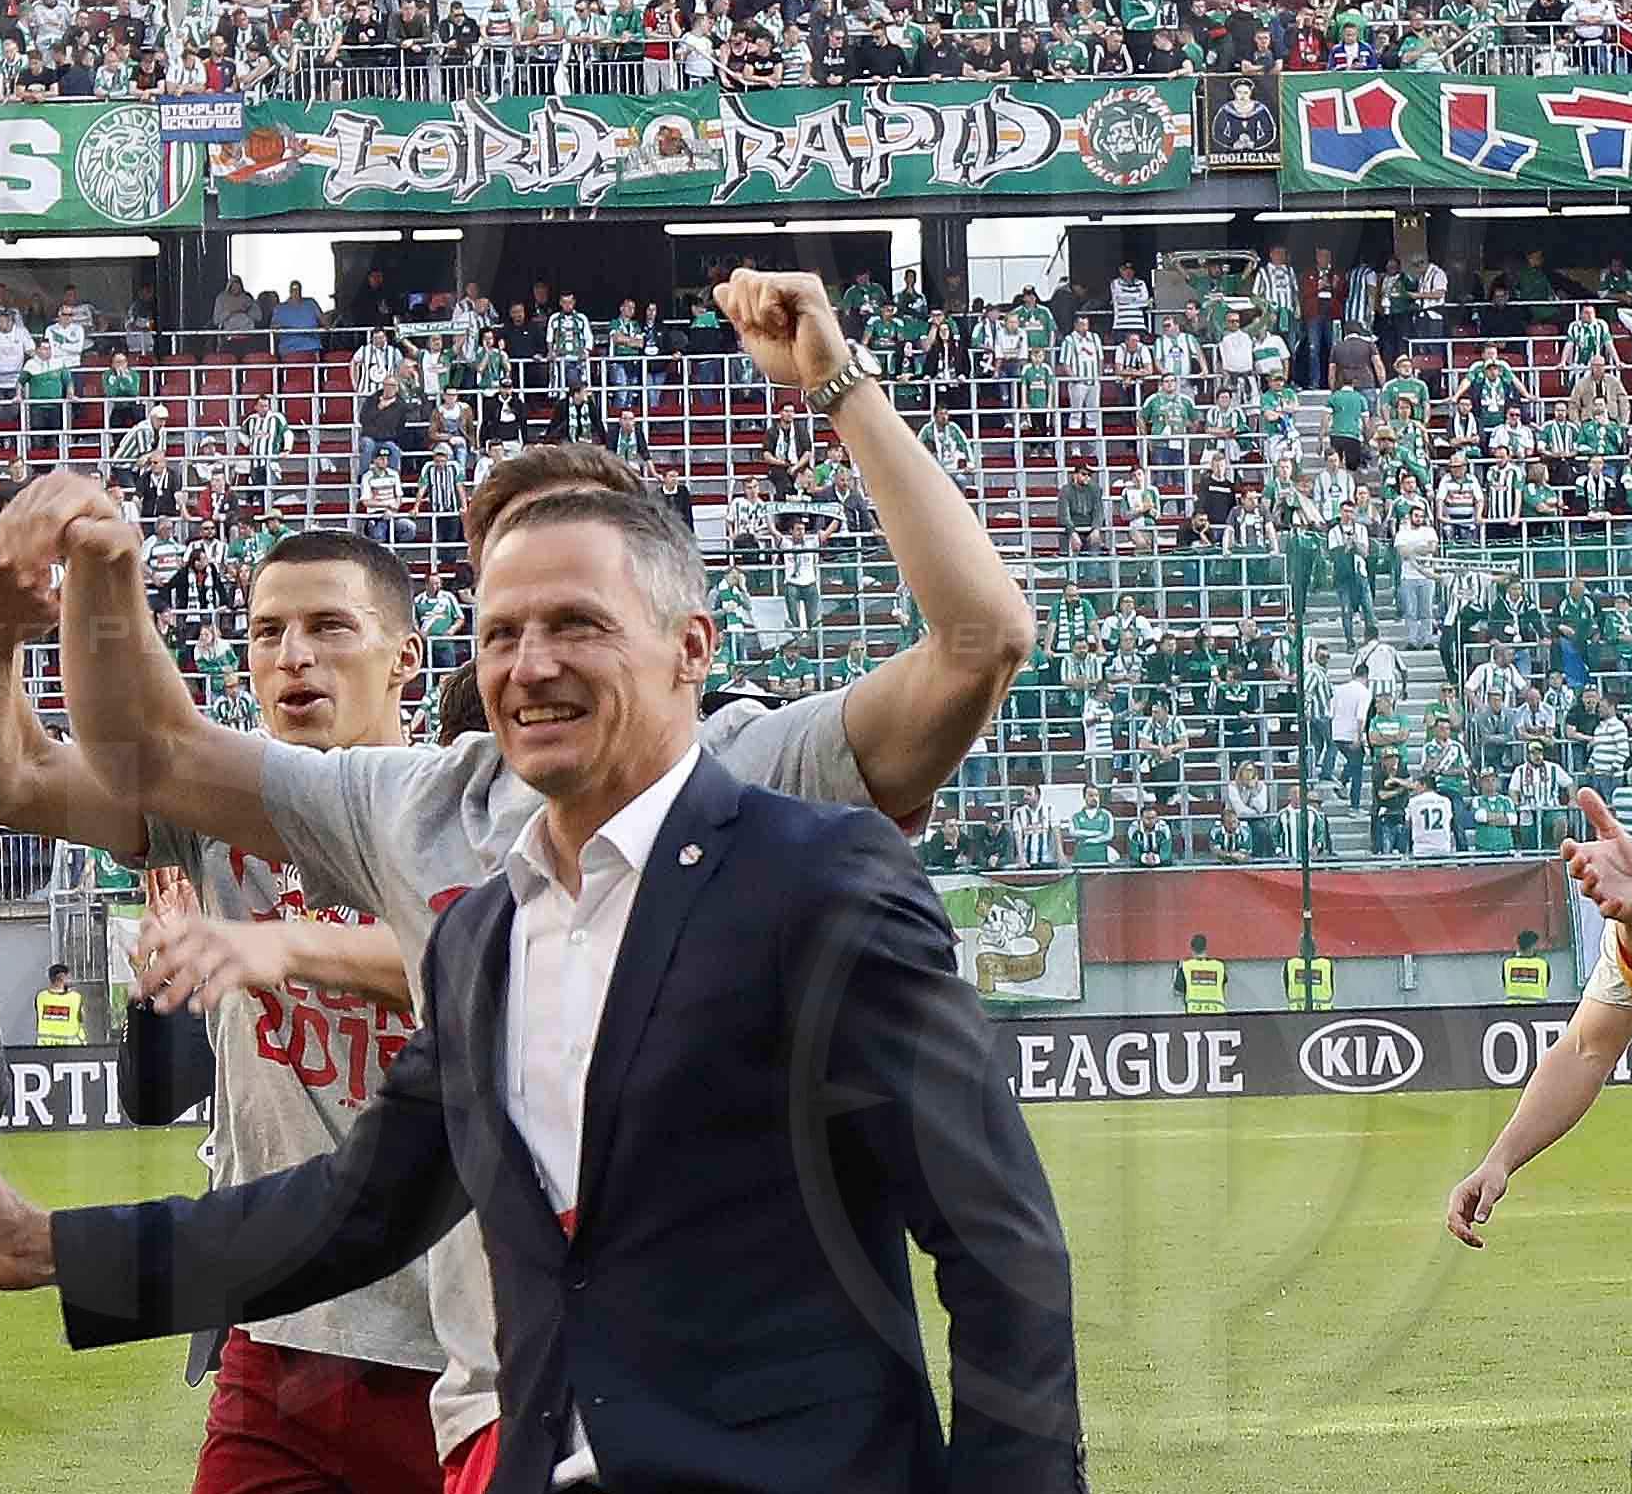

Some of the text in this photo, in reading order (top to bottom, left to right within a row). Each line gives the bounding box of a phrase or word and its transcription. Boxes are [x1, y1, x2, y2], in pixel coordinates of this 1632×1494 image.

[711, 84, 1061, 205] RAPID
[1209, 151, 1281, 167] HOOLIGANS
[1420, 808, 1443, 831] 12
[1008, 1029, 1245, 1099] EAGUE
[1320, 1036, 1405, 1077] KIA
